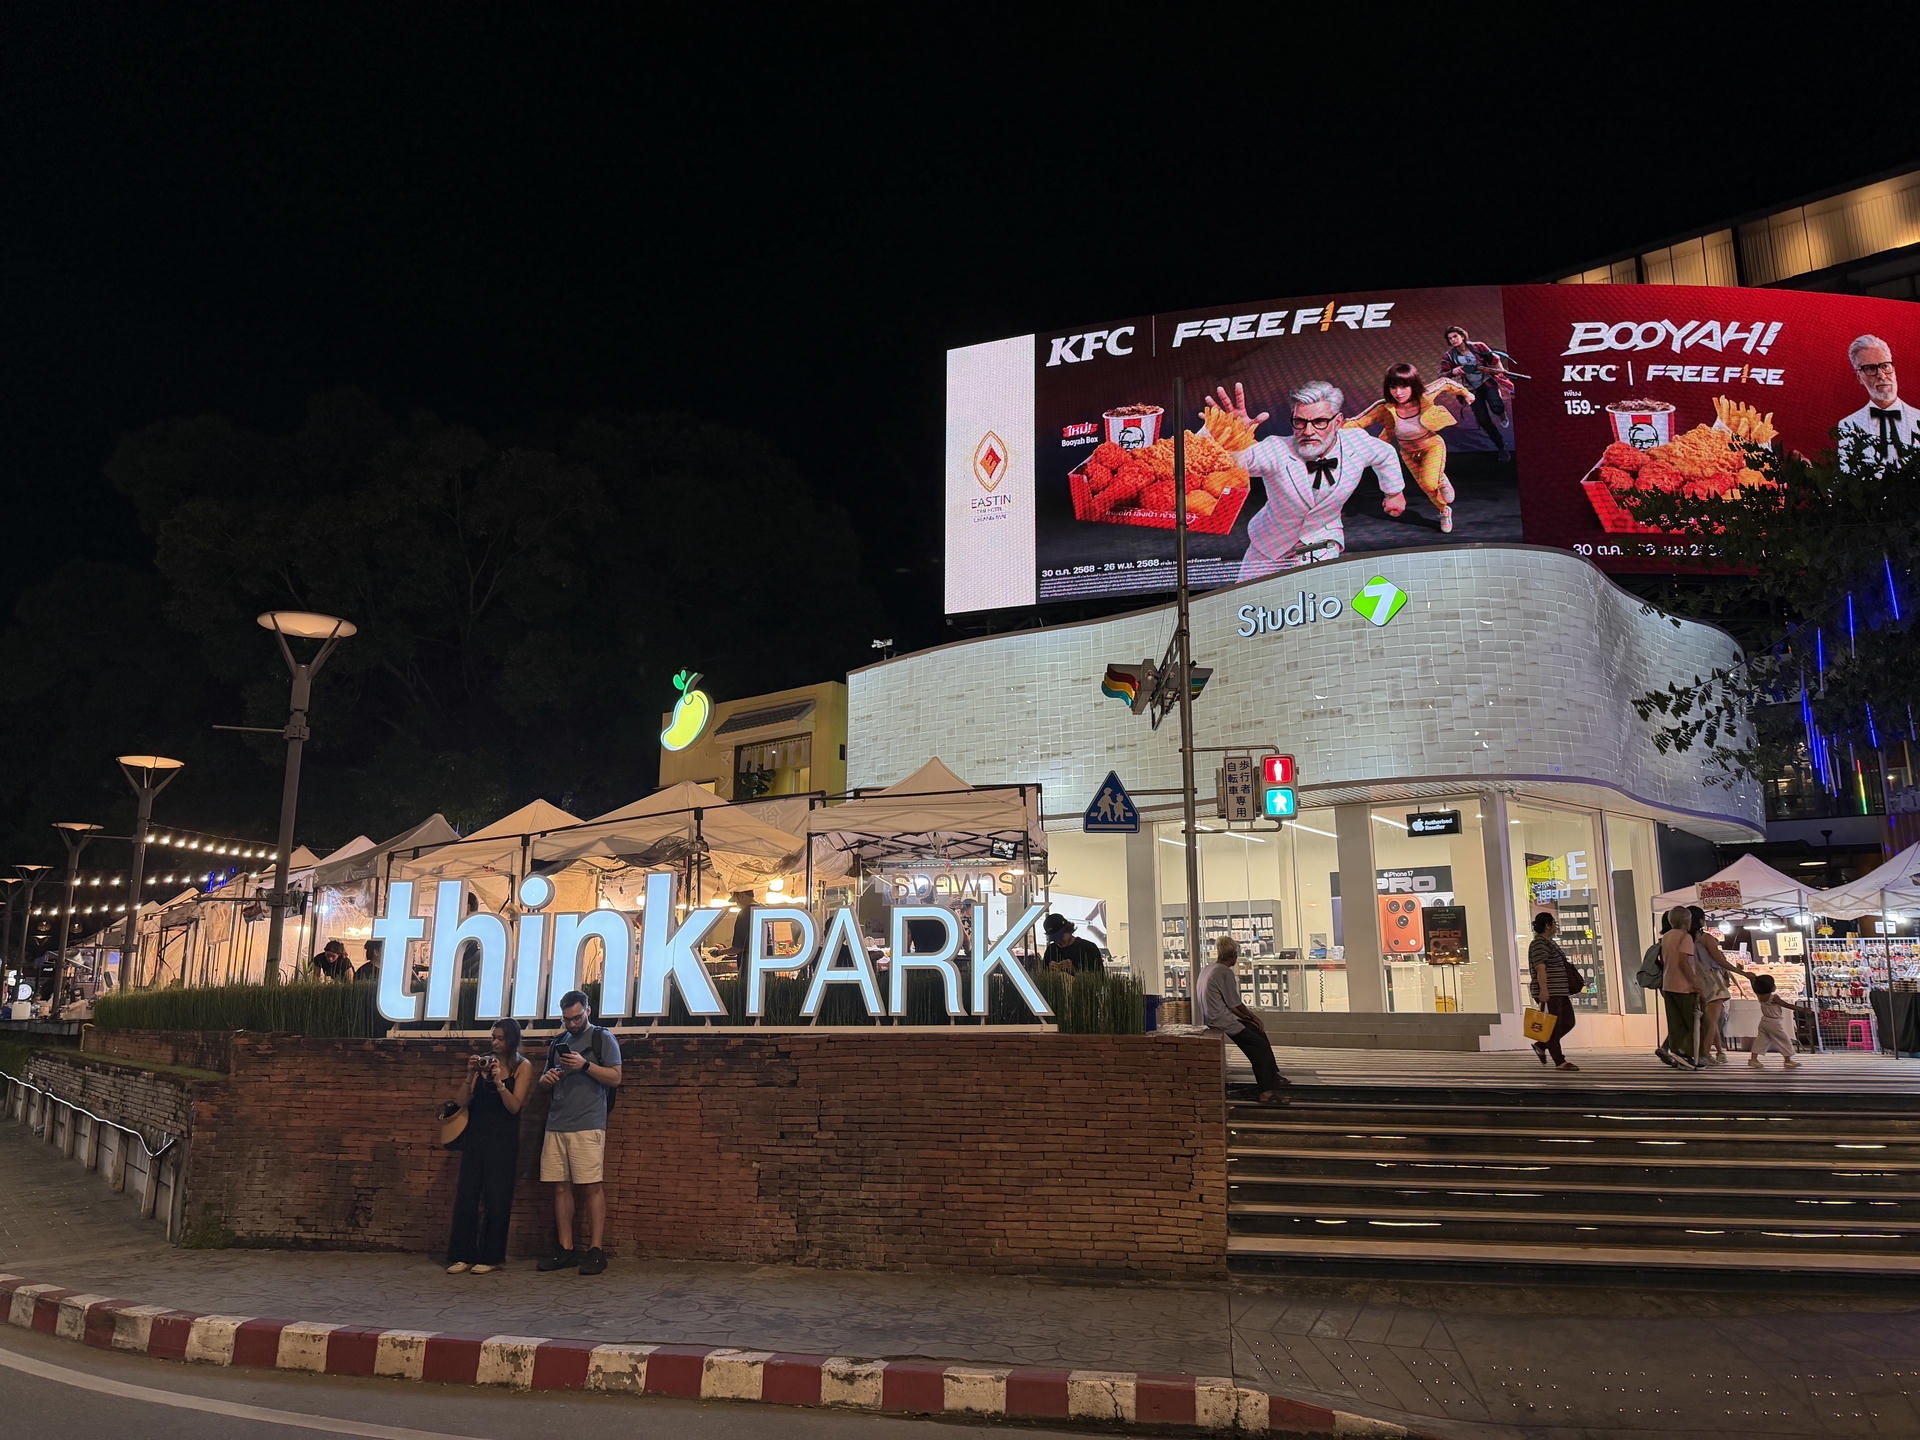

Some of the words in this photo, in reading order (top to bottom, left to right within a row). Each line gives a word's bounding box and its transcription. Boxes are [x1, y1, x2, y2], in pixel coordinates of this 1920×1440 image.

[1172, 311, 1290, 348] FREE
[1291, 301, 1396, 334] FIRE
[1046, 326, 1135, 366] KFC
[1560, 319, 1784, 356] BOOYAH!
[1562, 365, 1618, 382] KFC
[1646, 365, 1721, 383] FREE
[1723, 364, 1785, 385] FIRE
[1061, 436, 1085, 448] Booyah
[1085, 436, 1099, 445] Box
[971, 494, 1012, 509] EASTIN
[1573, 544, 1593, 556] 30
[1041, 569, 1053, 578] 30
[1073, 564, 1095, 574] 2568
[1103, 563, 1116, 572] 26
[1136, 558, 1160, 568] 2568
[1237, 591, 1343, 637] Studio
[1227, 762, 1239, 795] 自転車
[1240, 760, 1251, 794] 歩行者
[1236, 796, 1247, 818] 専用
[1376, 875, 1437, 893] PRO
[1428, 930, 1462, 939] PRO
[371, 872, 729, 1022] think
[744, 901, 1056, 1018] PARK
